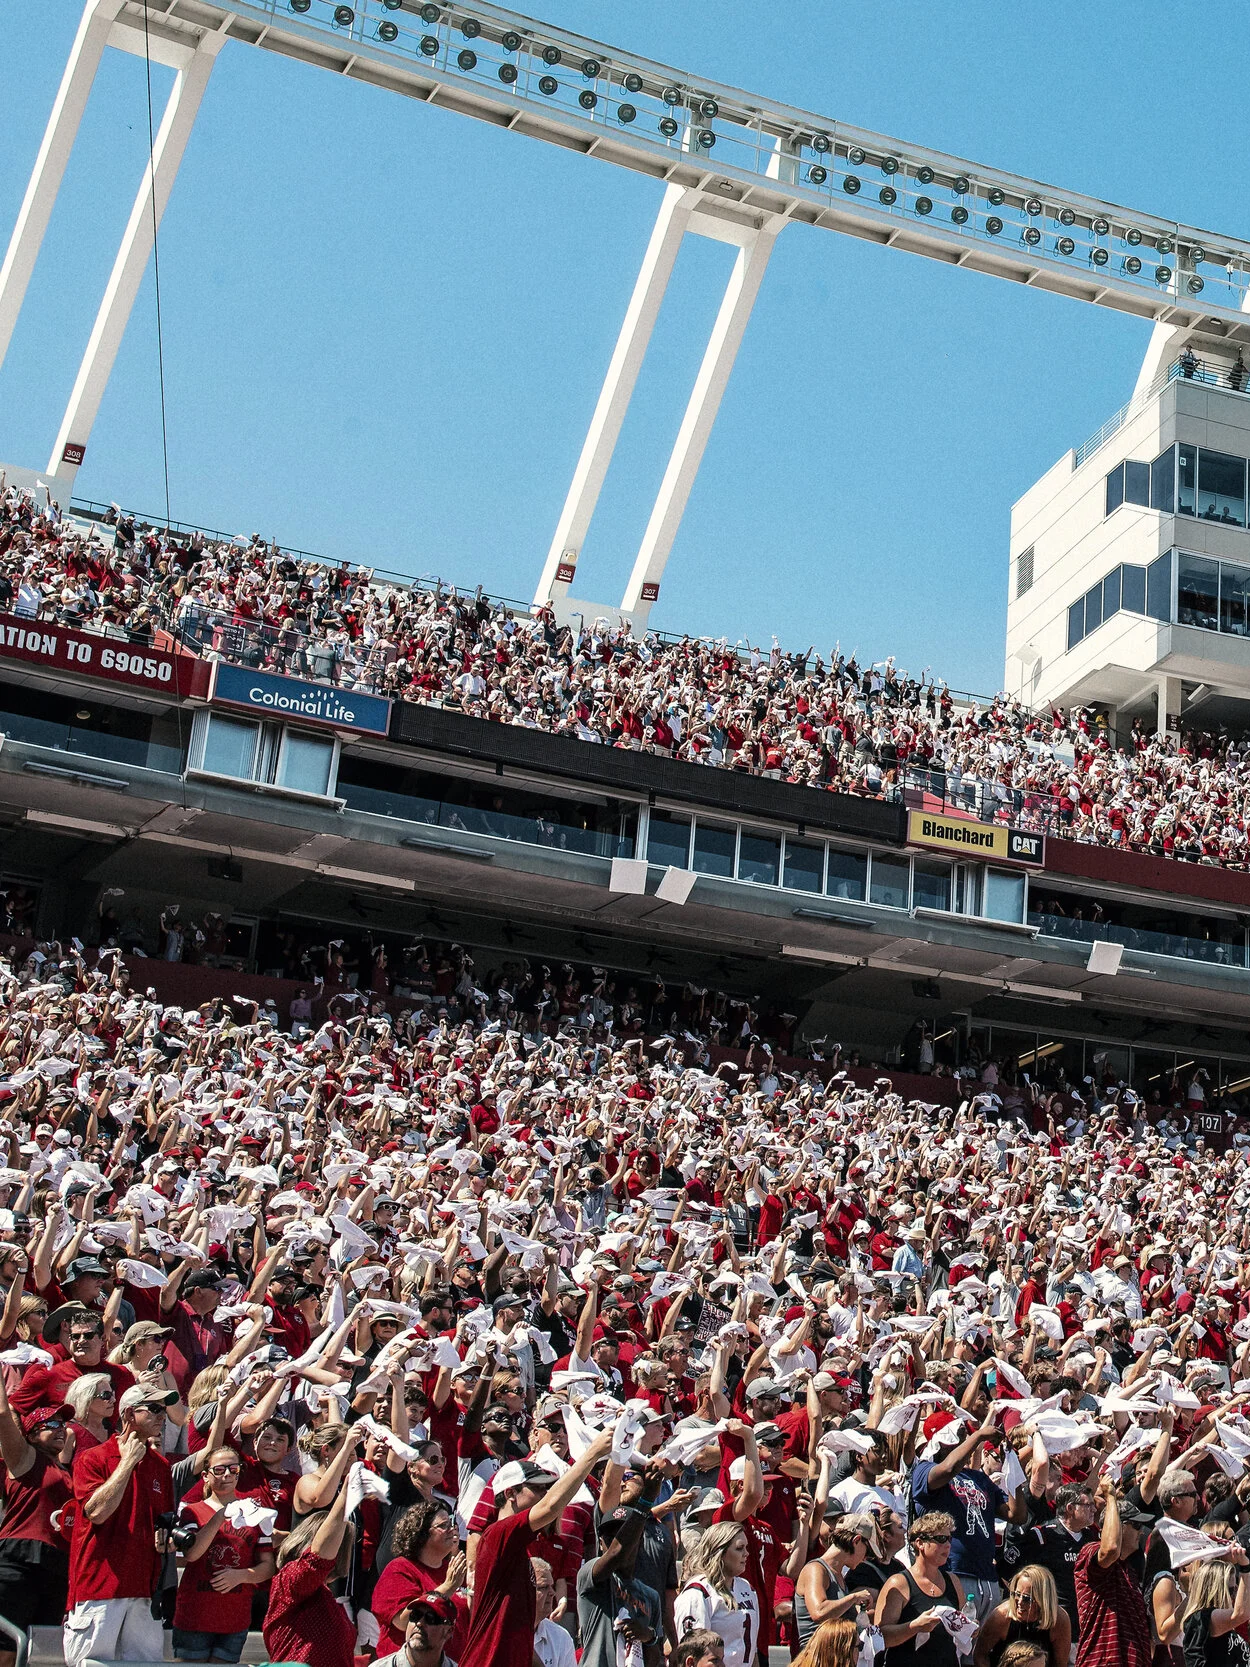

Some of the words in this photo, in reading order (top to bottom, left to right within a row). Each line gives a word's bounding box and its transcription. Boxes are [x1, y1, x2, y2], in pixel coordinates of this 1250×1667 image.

[66, 449, 81, 459] 308
[560, 568, 572, 577] 308
[643, 587, 656, 595] 307
[66, 639, 92, 663] TO
[101, 649, 172, 682] 69050
[249, 687, 322, 715] Colonial
[325, 700, 355, 722] Life
[922, 819, 994, 848] Blanchard
[1012, 835, 1038, 855] CAT
[1200, 1115, 1219, 1130] 107
[742, 1612, 752, 1664] 1
